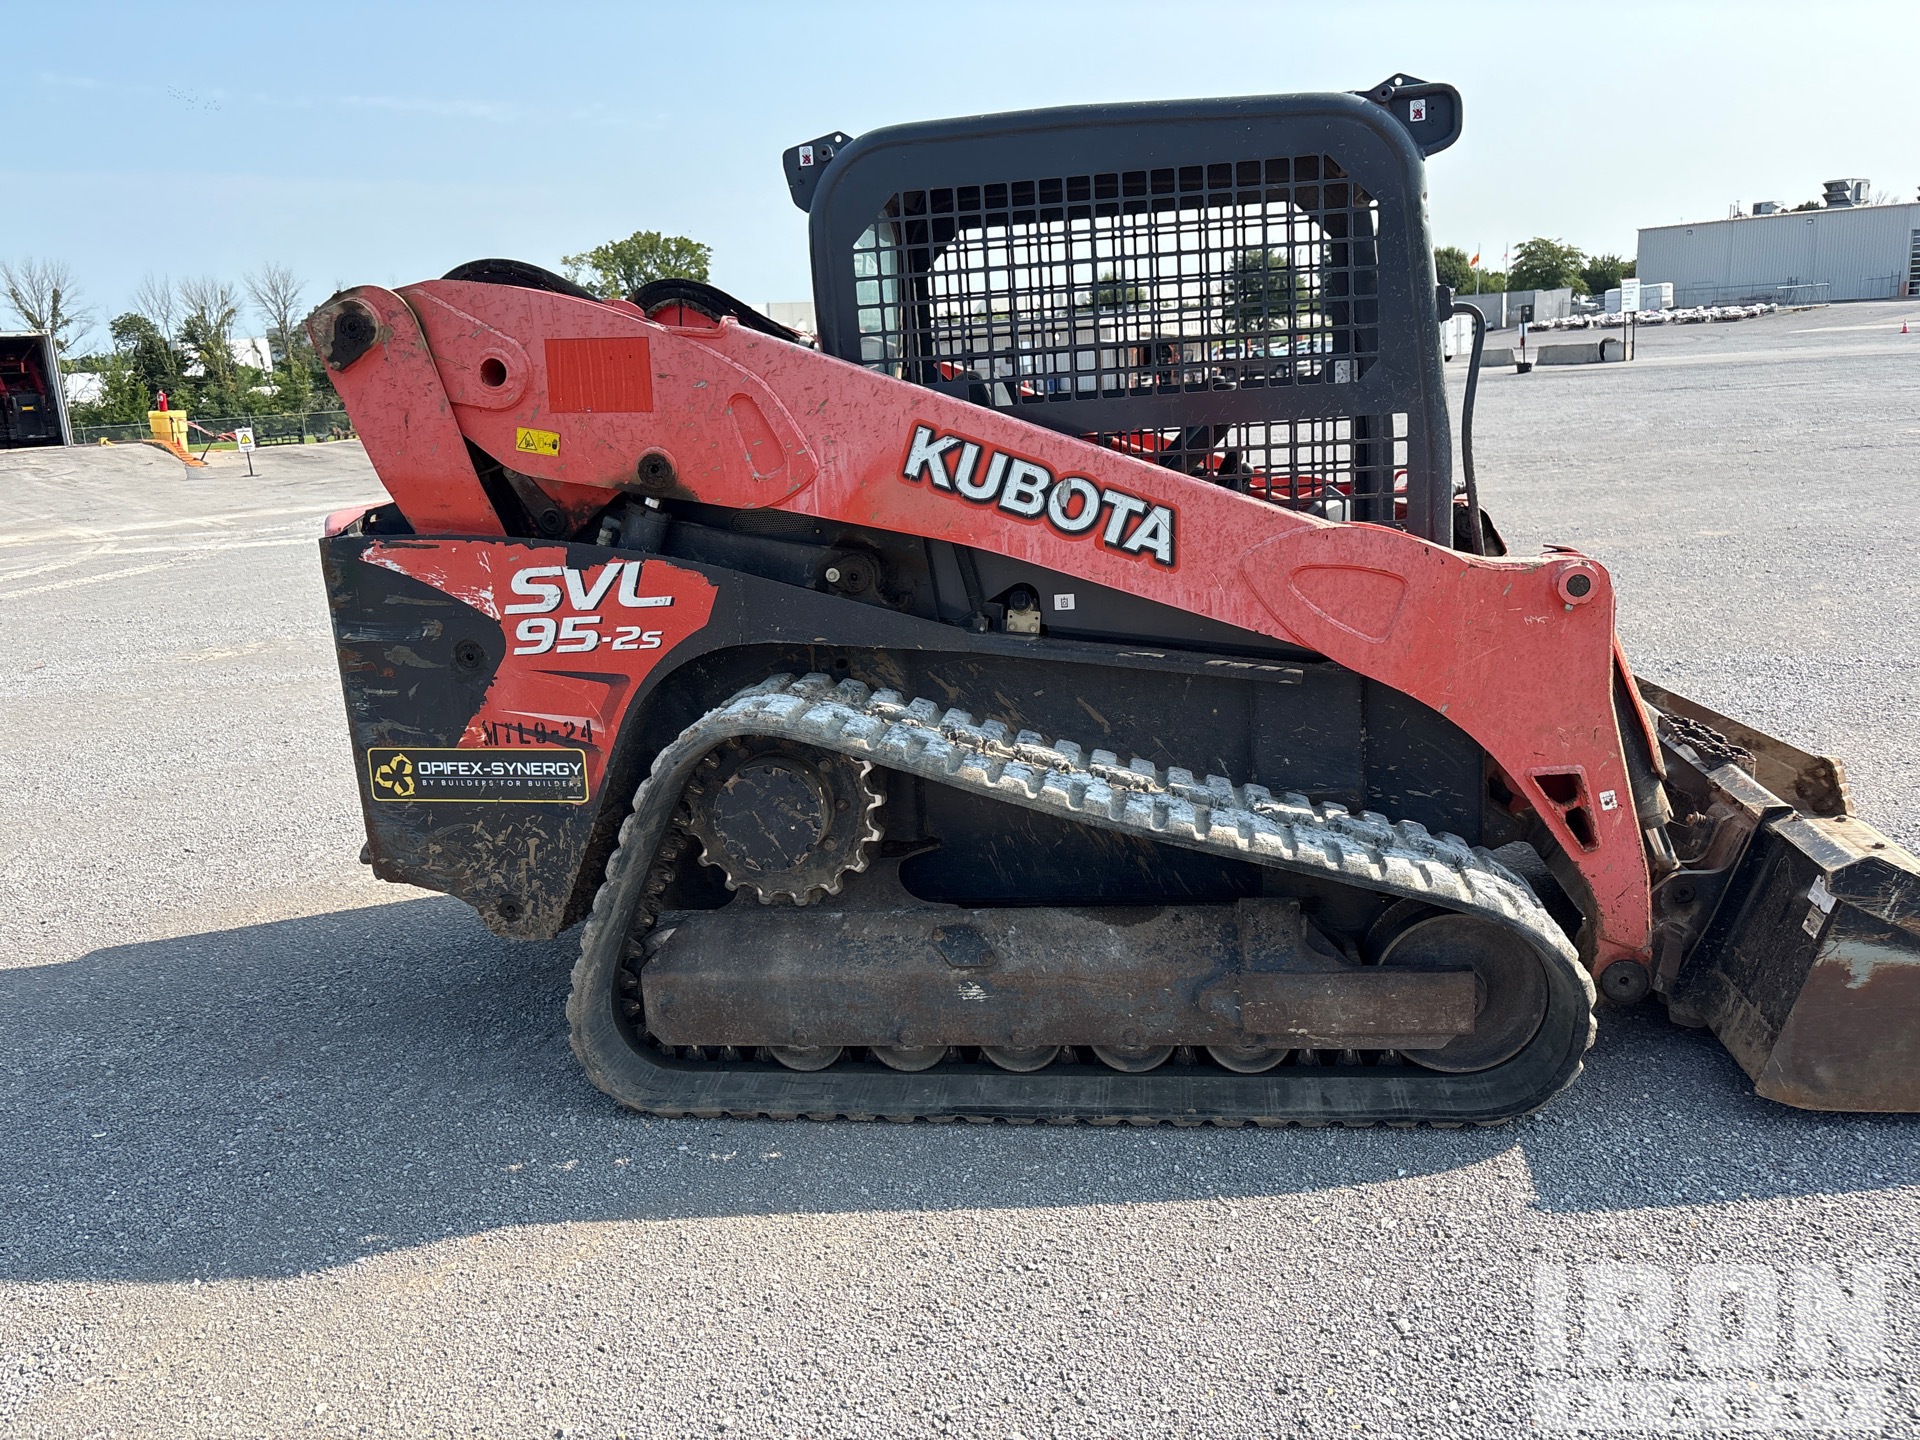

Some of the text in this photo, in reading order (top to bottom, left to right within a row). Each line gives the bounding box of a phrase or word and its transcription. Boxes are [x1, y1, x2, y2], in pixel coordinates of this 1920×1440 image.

[904, 426, 1173, 565] KUBOTA
[505, 561, 675, 614] SVL
[418, 761, 582, 776] OPIFEX-SYNERGY
[422, 779, 434, 787] BY
[441, 779, 494, 787] BUILDERS
[500, 779, 521, 787] FOR
